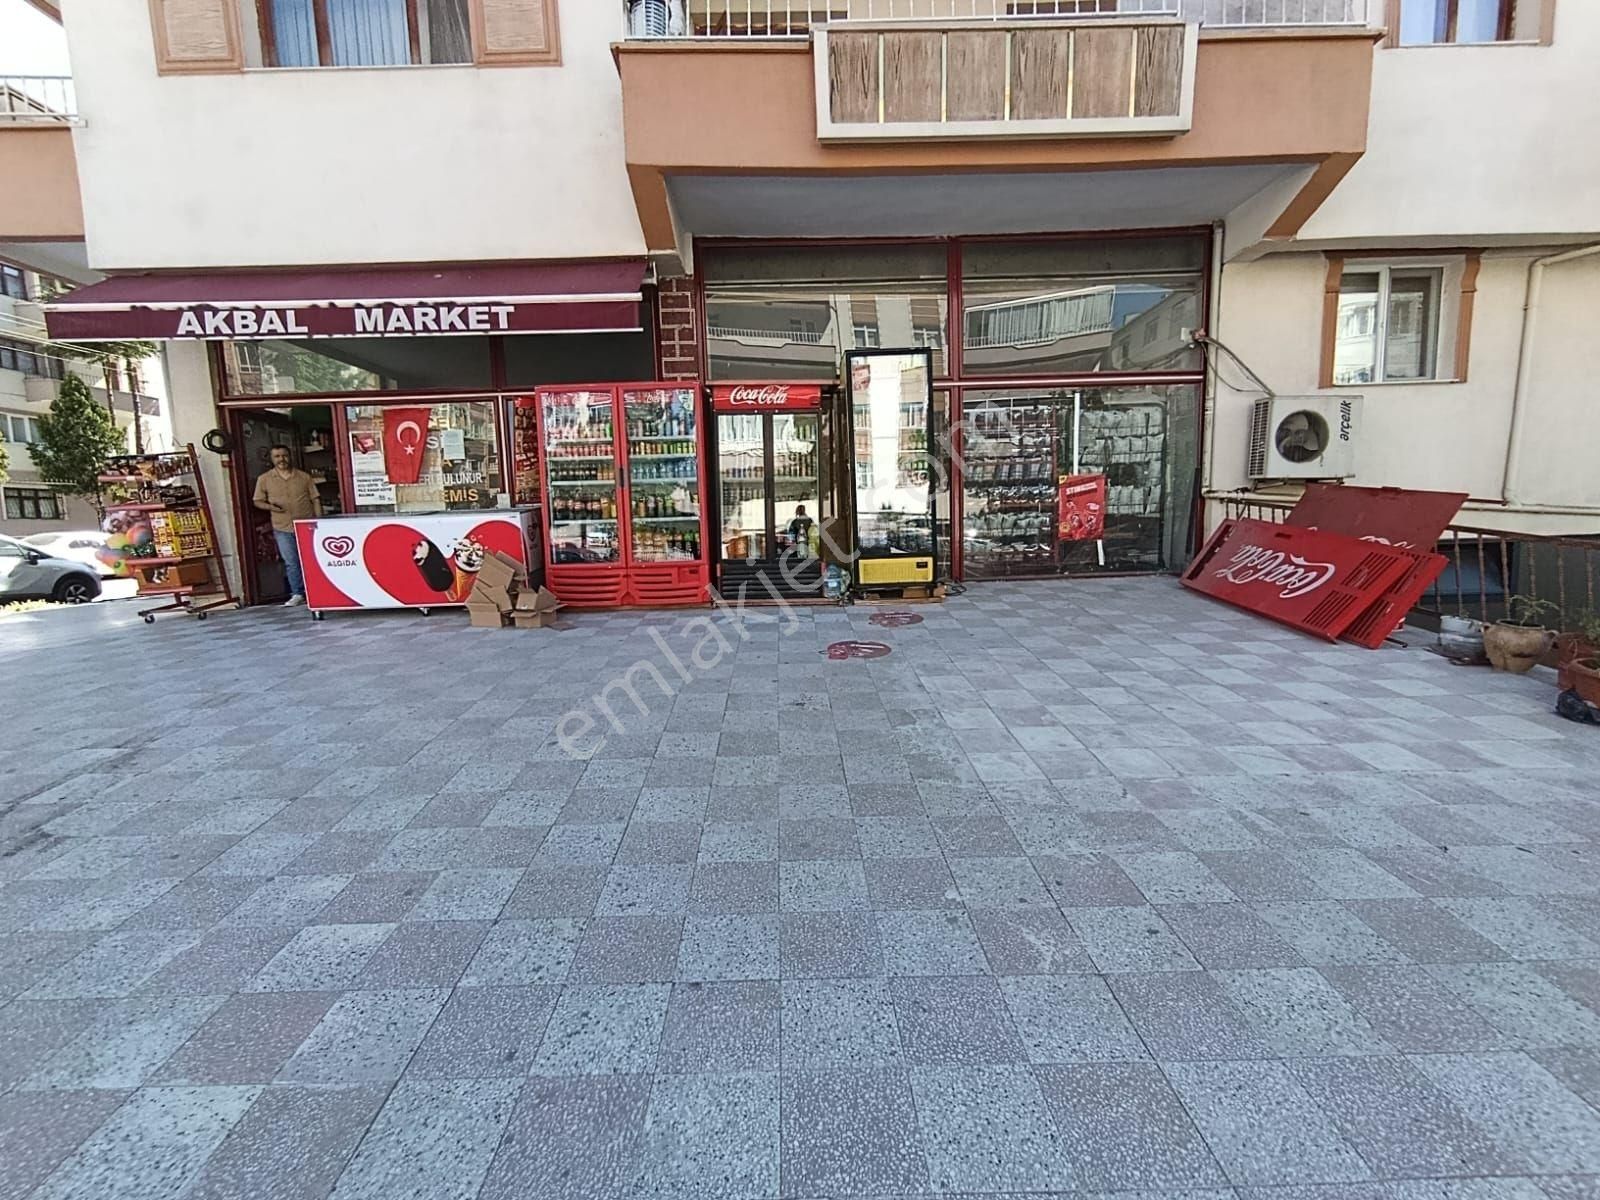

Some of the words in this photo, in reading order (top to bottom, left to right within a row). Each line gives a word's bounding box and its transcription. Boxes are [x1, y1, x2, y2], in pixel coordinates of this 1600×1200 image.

[176, 309, 309, 335] AKBAL
[354, 305, 515, 333] MARKET
[730, 385, 790, 405] Coca-Cola
[1339, 400, 1353, 441] arçelik
[1215, 543, 1336, 598] Coca-Cola
